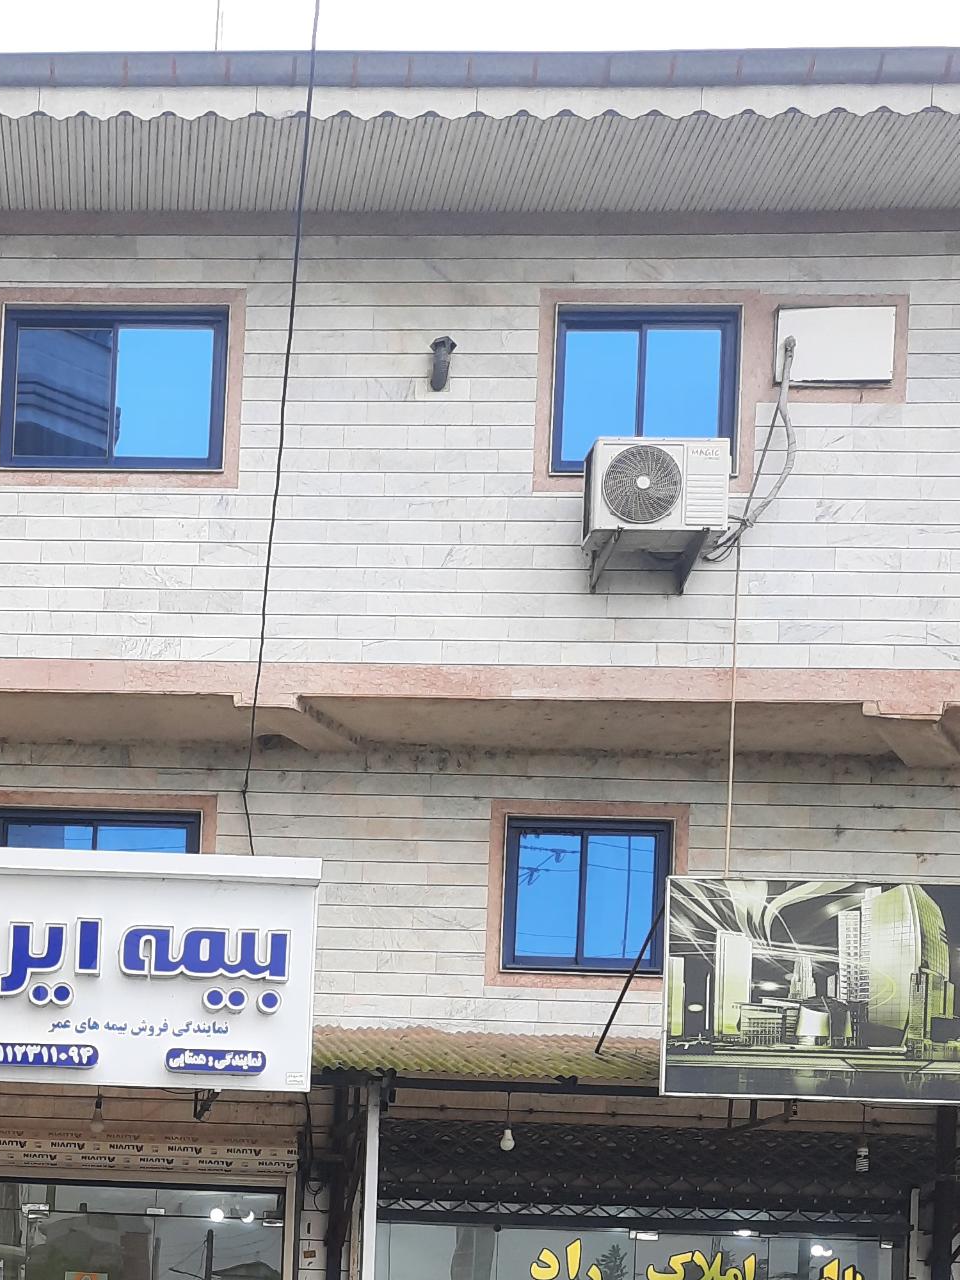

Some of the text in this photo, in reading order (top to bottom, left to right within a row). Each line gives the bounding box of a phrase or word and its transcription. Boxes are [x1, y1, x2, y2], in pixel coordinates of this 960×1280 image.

[120, 925, 292, 1014] بیمه
[47, 1018, 230, 1038] نمایندگی فروش بیمه های عمر
